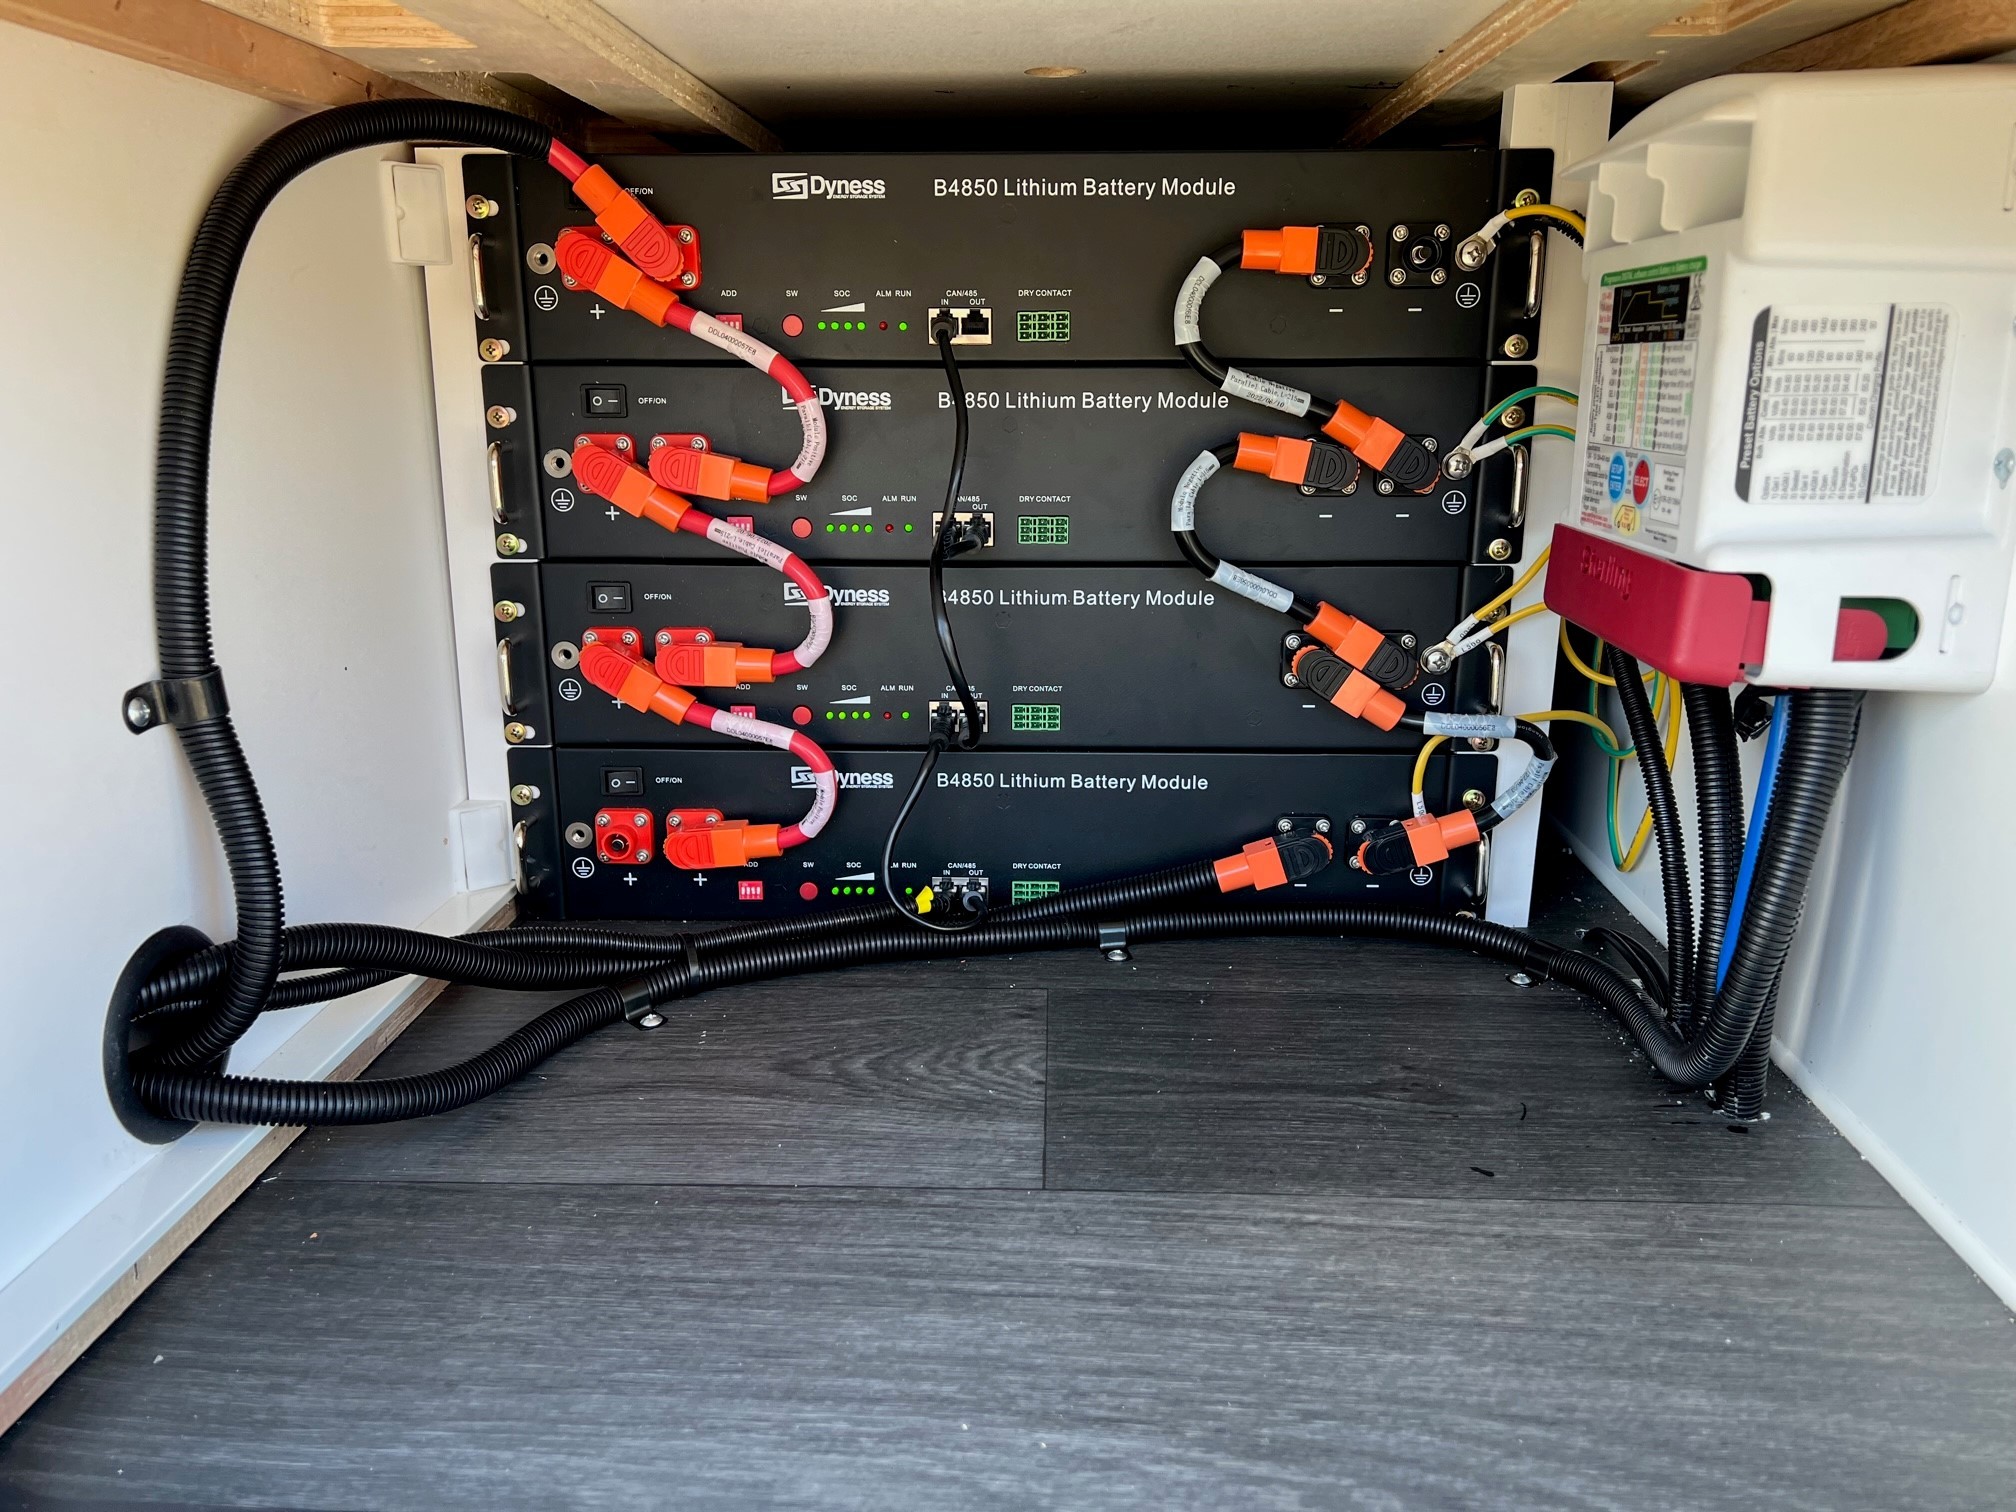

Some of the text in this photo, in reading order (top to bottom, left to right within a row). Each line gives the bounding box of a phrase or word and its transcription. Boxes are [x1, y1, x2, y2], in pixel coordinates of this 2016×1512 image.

[810, 175, 886, 200] Dyness
[934, 177, 1236, 201] B4850 Lithium Battery Module
[720, 289, 738, 297] ADD
[785, 289, 799, 297] SW
[833, 289, 851, 298] SOC
[875, 289, 892, 297] ALM
[895, 289, 912, 298] RUN
[945, 289, 978, 297] CAN/485
[1018, 289, 1073, 297] DRY CONTACT
[940, 298, 949, 306] IN
[969, 297, 986, 306] OUT
[1231, 375, 1257, 389] Parallel
[637, 397, 667, 405] OFF/ON
[818, 386, 892, 411] Dyness
[938, 391, 1230, 413] B850 Lithium Battery Module
[1740, 341, 1765, 468] Preset Battery Options
[795, 494, 808, 502] SW
[841, 494, 858, 502] SOC
[900, 495, 917, 503] RUN
[1018, 495, 1071, 503] DRY CONTACT
[643, 593, 672, 601] OFF/ON
[999, 589, 1067, 606] Lithium
[1073, 589, 1141, 610] Battery
[1145, 589, 1215, 606] Module
[734, 683, 751, 691] ADD
[841, 684, 857, 692] SOC
[880, 684, 896, 692] ALM
[898, 684, 914, 692] RUN
[1028, 685, 1063, 693] CONTACT
[655, 776, 683, 784] OFF/ON
[834, 769, 894, 789] yness
[937, 772, 1209, 793] B4850 Lithium Battery Module
[846, 861, 862, 869] SOC
[947, 862, 977, 870] CAN/485
[1012, 862, 1062, 870] DRY CONTACT
